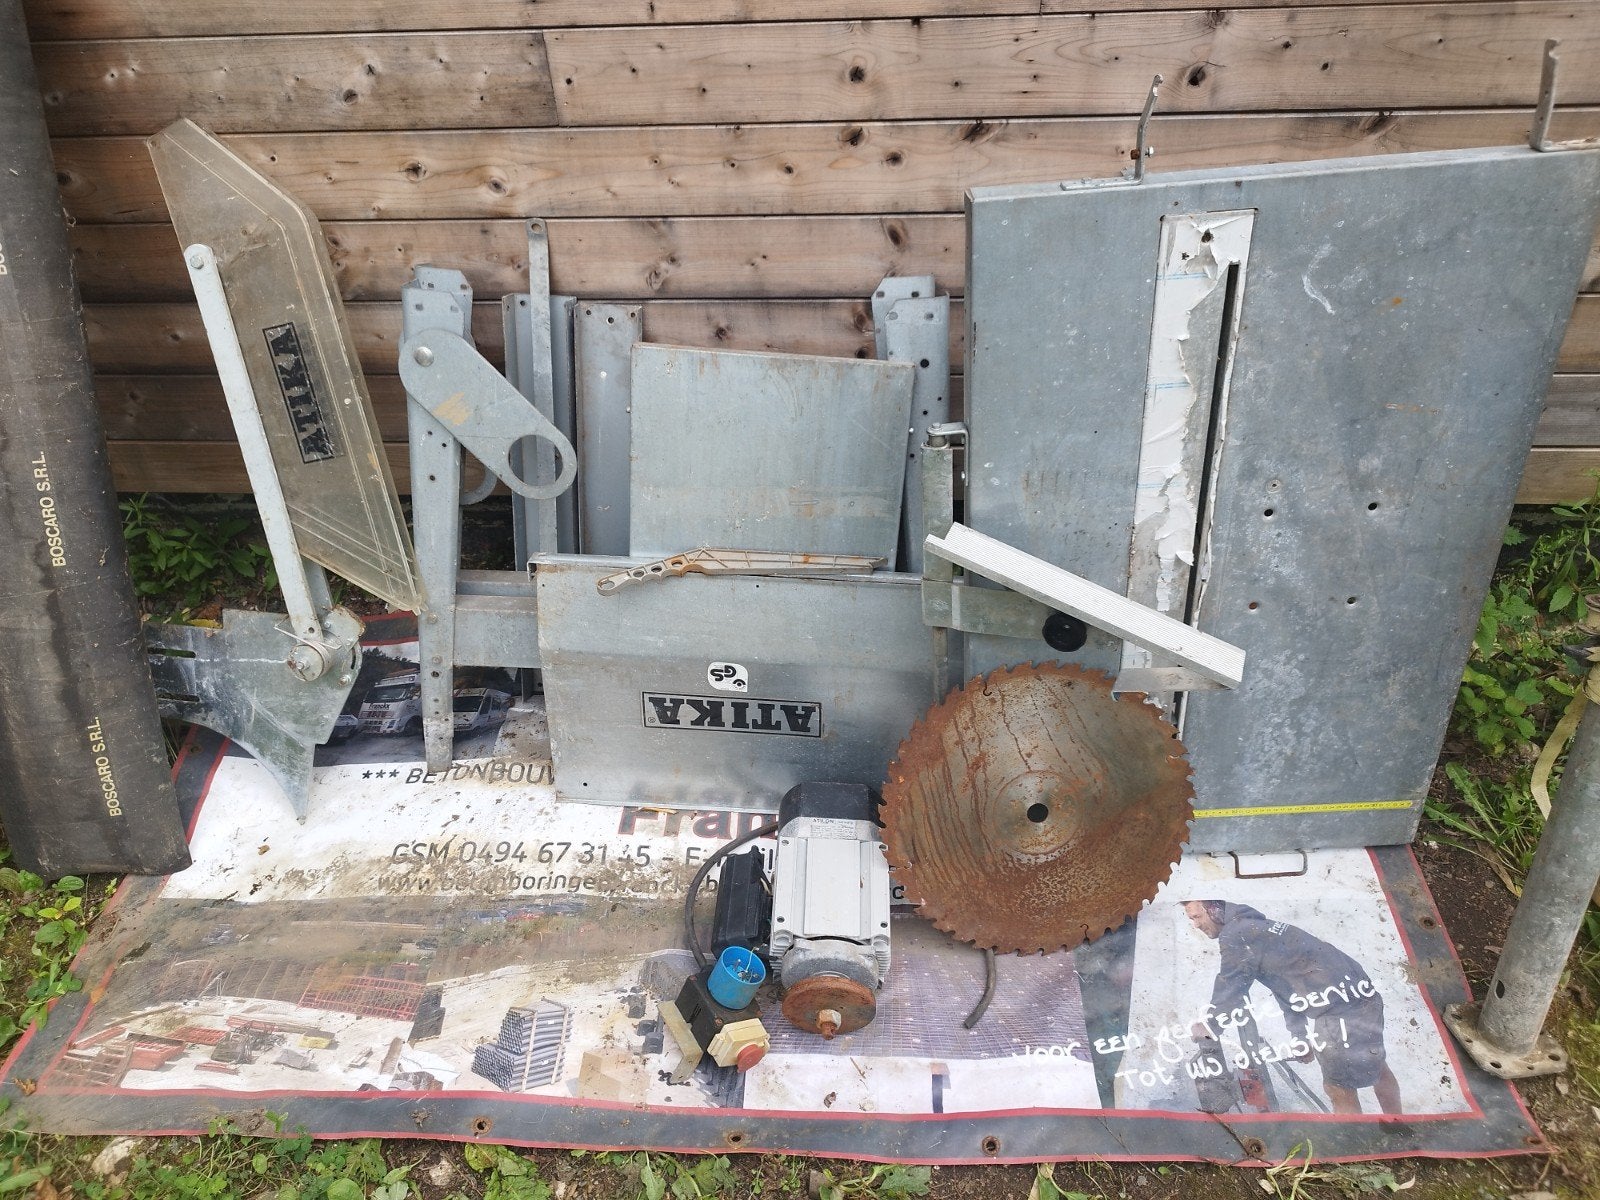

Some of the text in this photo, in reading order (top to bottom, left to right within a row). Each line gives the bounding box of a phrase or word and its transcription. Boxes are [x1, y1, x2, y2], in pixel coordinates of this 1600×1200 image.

[271, 328, 330, 455] ATIKA
[32, 451, 67, 567] BOSCARO S.R.L.
[648, 697, 817, 732] ATIKA
[87, 716, 122, 817] BOSCARO S.R.L.
[405, 761, 555, 785] BETONBOU
[392, 842, 453, 865] GSM
[458, 841, 528, 863] 0494
[538, 842, 572, 863] 67
[578, 842, 608, 866] 31
